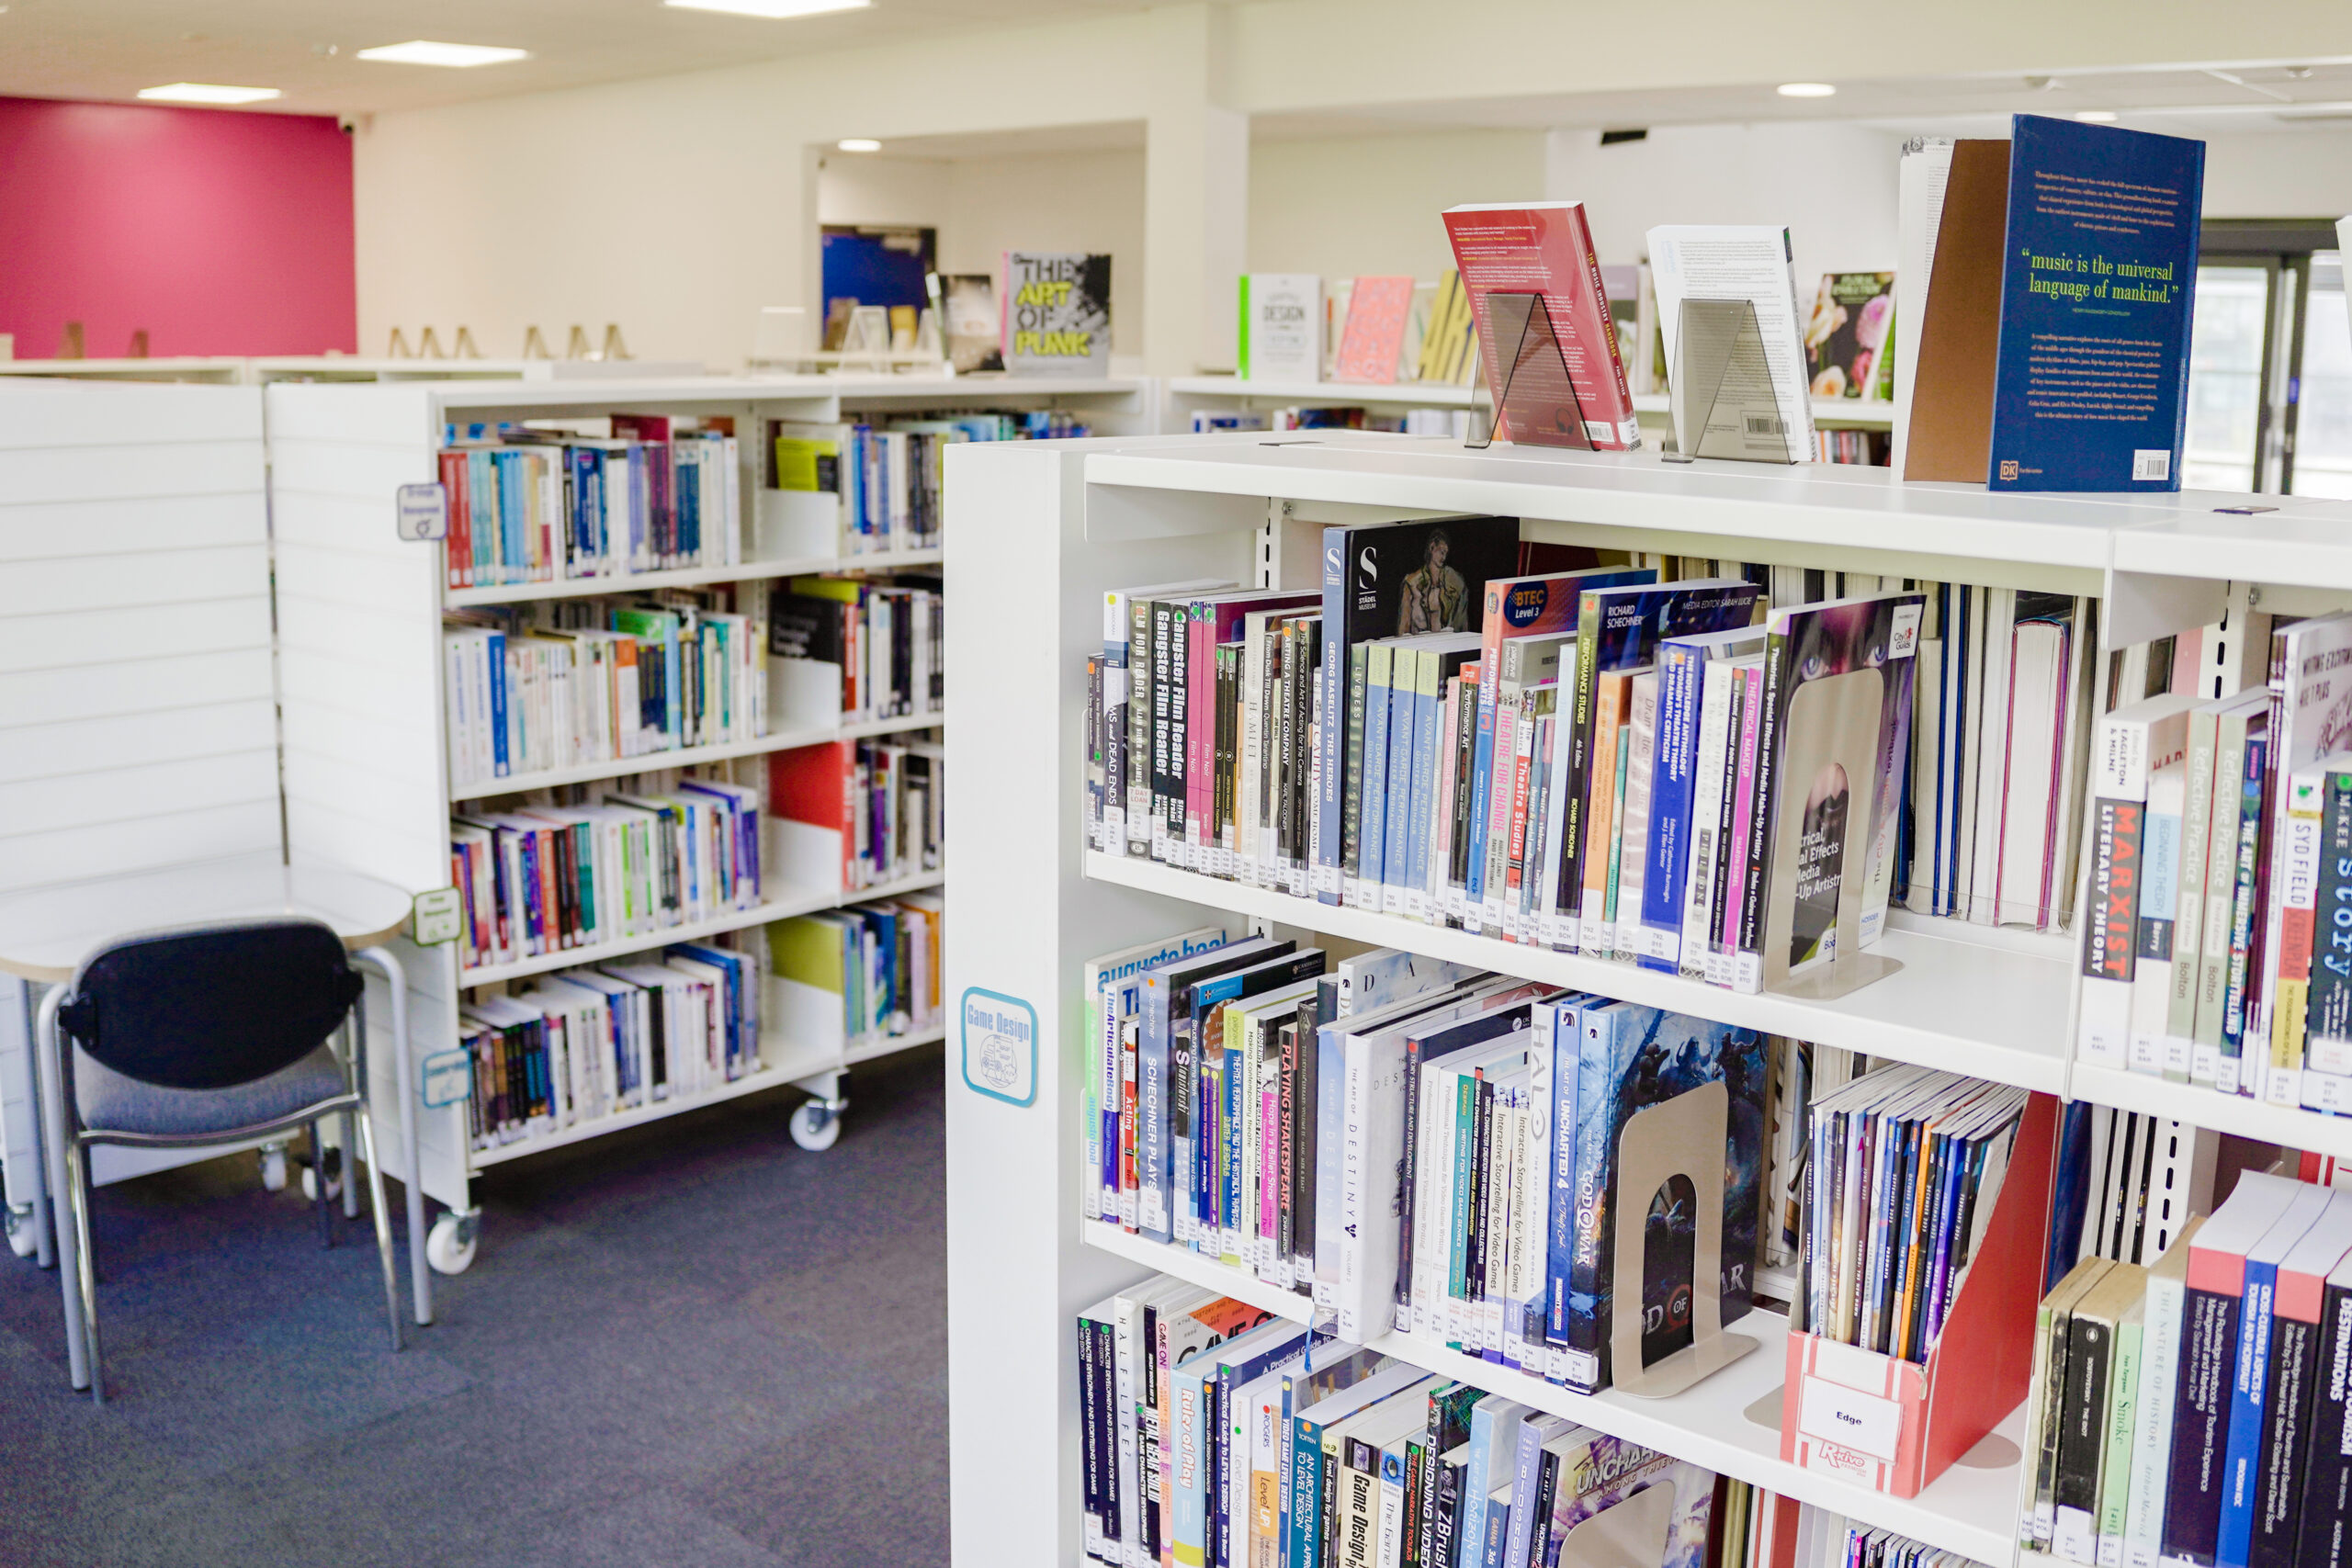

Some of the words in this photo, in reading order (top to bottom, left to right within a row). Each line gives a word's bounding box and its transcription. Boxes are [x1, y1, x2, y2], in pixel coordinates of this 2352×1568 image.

[1013, 255, 1079, 281] THE
[2021, 247, 2074, 272] “music
[2077, 254, 2088, 272] is
[2092, 255, 2113, 275] the
[2117, 260, 2173, 280] universal
[1017, 283, 1071, 306] ART
[2030, 273, 2089, 300] language
[2094, 279, 2109, 298] of
[2112, 282, 2178, 303] mankind.”
[1017, 308, 1055, 330] OF
[1263, 305, 1306, 321] DESIGN
[1591, 267, 1600, 288] MUSIC
[1597, 289, 1608, 321] INDUSTRY
[1605, 323, 1617, 357] HANDBOOK
[1015, 332, 1090, 355] PUNK
[2002, 465, 2016, 476] DK
[1516, 590, 1544, 606] BTEC
[1516, 607, 1533, 618] Level
[1535, 607, 1540, 616] 3
[1609, 605, 1635, 616] RICHARD
[1607, 616, 1643, 629] SCHECHNER
[1156, 611, 1170, 682] Gangster
[1172, 610, 1186, 685] Gangster
[1298, 646, 1306, 673] Science
[1487, 648, 1498, 706] PERFORMING
[1579, 637, 1590, 694] PERFORMANCE
[1769, 647, 1780, 691] Theatrical,
[1155, 684, 1169, 717] Film
[1171, 687, 1185, 719] Film
[1462, 688, 1473, 734] Performance
[1577, 695, 1587, 725] STUDIES
[1744, 681, 1758, 735] THEATRICAL
[1765, 693, 1776, 721] Special
[1296, 710, 1305, 732] Acting
[1480, 715, 1490, 729] 3
[1498, 710, 1512, 759] THEATRE
[1763, 723, 1774, 750] Effects
[1156, 719, 1169, 775] Reader
[1171, 722, 1184, 779] Reader
[1295, 734, 1305, 744] for
[1886, 721, 1897, 773] textbook
[1108, 742, 1117, 772] DEAD
[1295, 759, 1304, 785] Camera
[1498, 762, 1510, 782] FOR
[1741, 738, 1753, 778] MAKEUP
[1761, 750, 1771, 766] and
[2119, 728, 2128, 786] EAGLETON
[1108, 776, 1116, 805] ENDS
[1326, 758, 1334, 802] HEROES
[1516, 761, 1528, 807] Theatre
[1759, 768, 1770, 792] Media
[1492, 784, 1509, 832] CHANGE
[1570, 798, 1578, 823] RICHARD
[1755, 794, 1768, 829] Make-Up
[1511, 812, 1524, 855] Studies
[1567, 825, 1576, 859] SCHECHNER
[1751, 829, 1764, 861] Artistry
[2098, 804, 2113, 895] LITERARY
[2294, 825, 2311, 853] SYD
[1811, 841, 1839, 863] Effects
[2104, 806, 2138, 976] MARXIST
[2290, 859, 2310, 906] FIELD
[1558, 931, 1571, 940] SCH
[2091, 901, 2109, 974] THEORY
[2150, 921, 2164, 953] Barry
[2177, 962, 2190, 999] Bolton
[2206, 965, 2219, 1003] Bolton
[967, 1004, 993, 1031] Game
[997, 1012, 1029, 1043] Design
[1281, 1044, 1292, 1108] PLAYING
[1125, 1096, 1134, 1131] Acting
[1147, 1057, 1158, 1144] SCHECHNER
[1556, 1100, 1569, 1175] UNCHARTED
[1148, 1145, 1158, 1190] PLAYS
[1280, 1111, 1292, 1210] SHAKESPEARE
[1556, 1177, 1569, 1190] 4
[1673, 1296, 1688, 1314] OF
[1159, 1323, 1167, 1350] GAME
[2330, 1297, 2352, 1403] DESTINATIONS
[1159, 1350, 1167, 1367] ON
[2084, 1357, 2094, 1402] DOSTOYEVSKY
[1182, 1388, 1195, 1431] Rules
[1221, 1382, 1229, 1415] Practical
[1221, 1416, 1229, 1445] Guide
[1262, 1414, 1272, 1449] ROGERS
[1836, 1411, 1862, 1426] Edge
[2115, 1401, 2131, 1446] Smoke
[1182, 1434, 1195, 1452] of
[1222, 1448, 1228, 1456] to
[1298, 1433, 1317, 1445] TOTTEN
[1180, 1453, 1195, 1489] Play
[1221, 1457, 1229, 1484] LEVEL
[1297, 1451, 1306, 1464] TO
[1306, 1453, 1315, 1471] AN
[1297, 1466, 1306, 1490] LEVEL
[1353, 1473, 1370, 1513] Game
[1423, 1435, 1437, 1519] DESIGNING
[1295, 1491, 1305, 1529] DESIGN
[1304, 1472, 1315, 1542] ARCHITECTURAL
[1385, 1502, 1395, 1527] The
[1351, 1516, 1369, 1563] Design
[1384, 1529, 1393, 1565] Game
[1420, 1522, 1432, 1568] VIDEO
[1536, 1523, 1546, 1564] UNCHARTED
